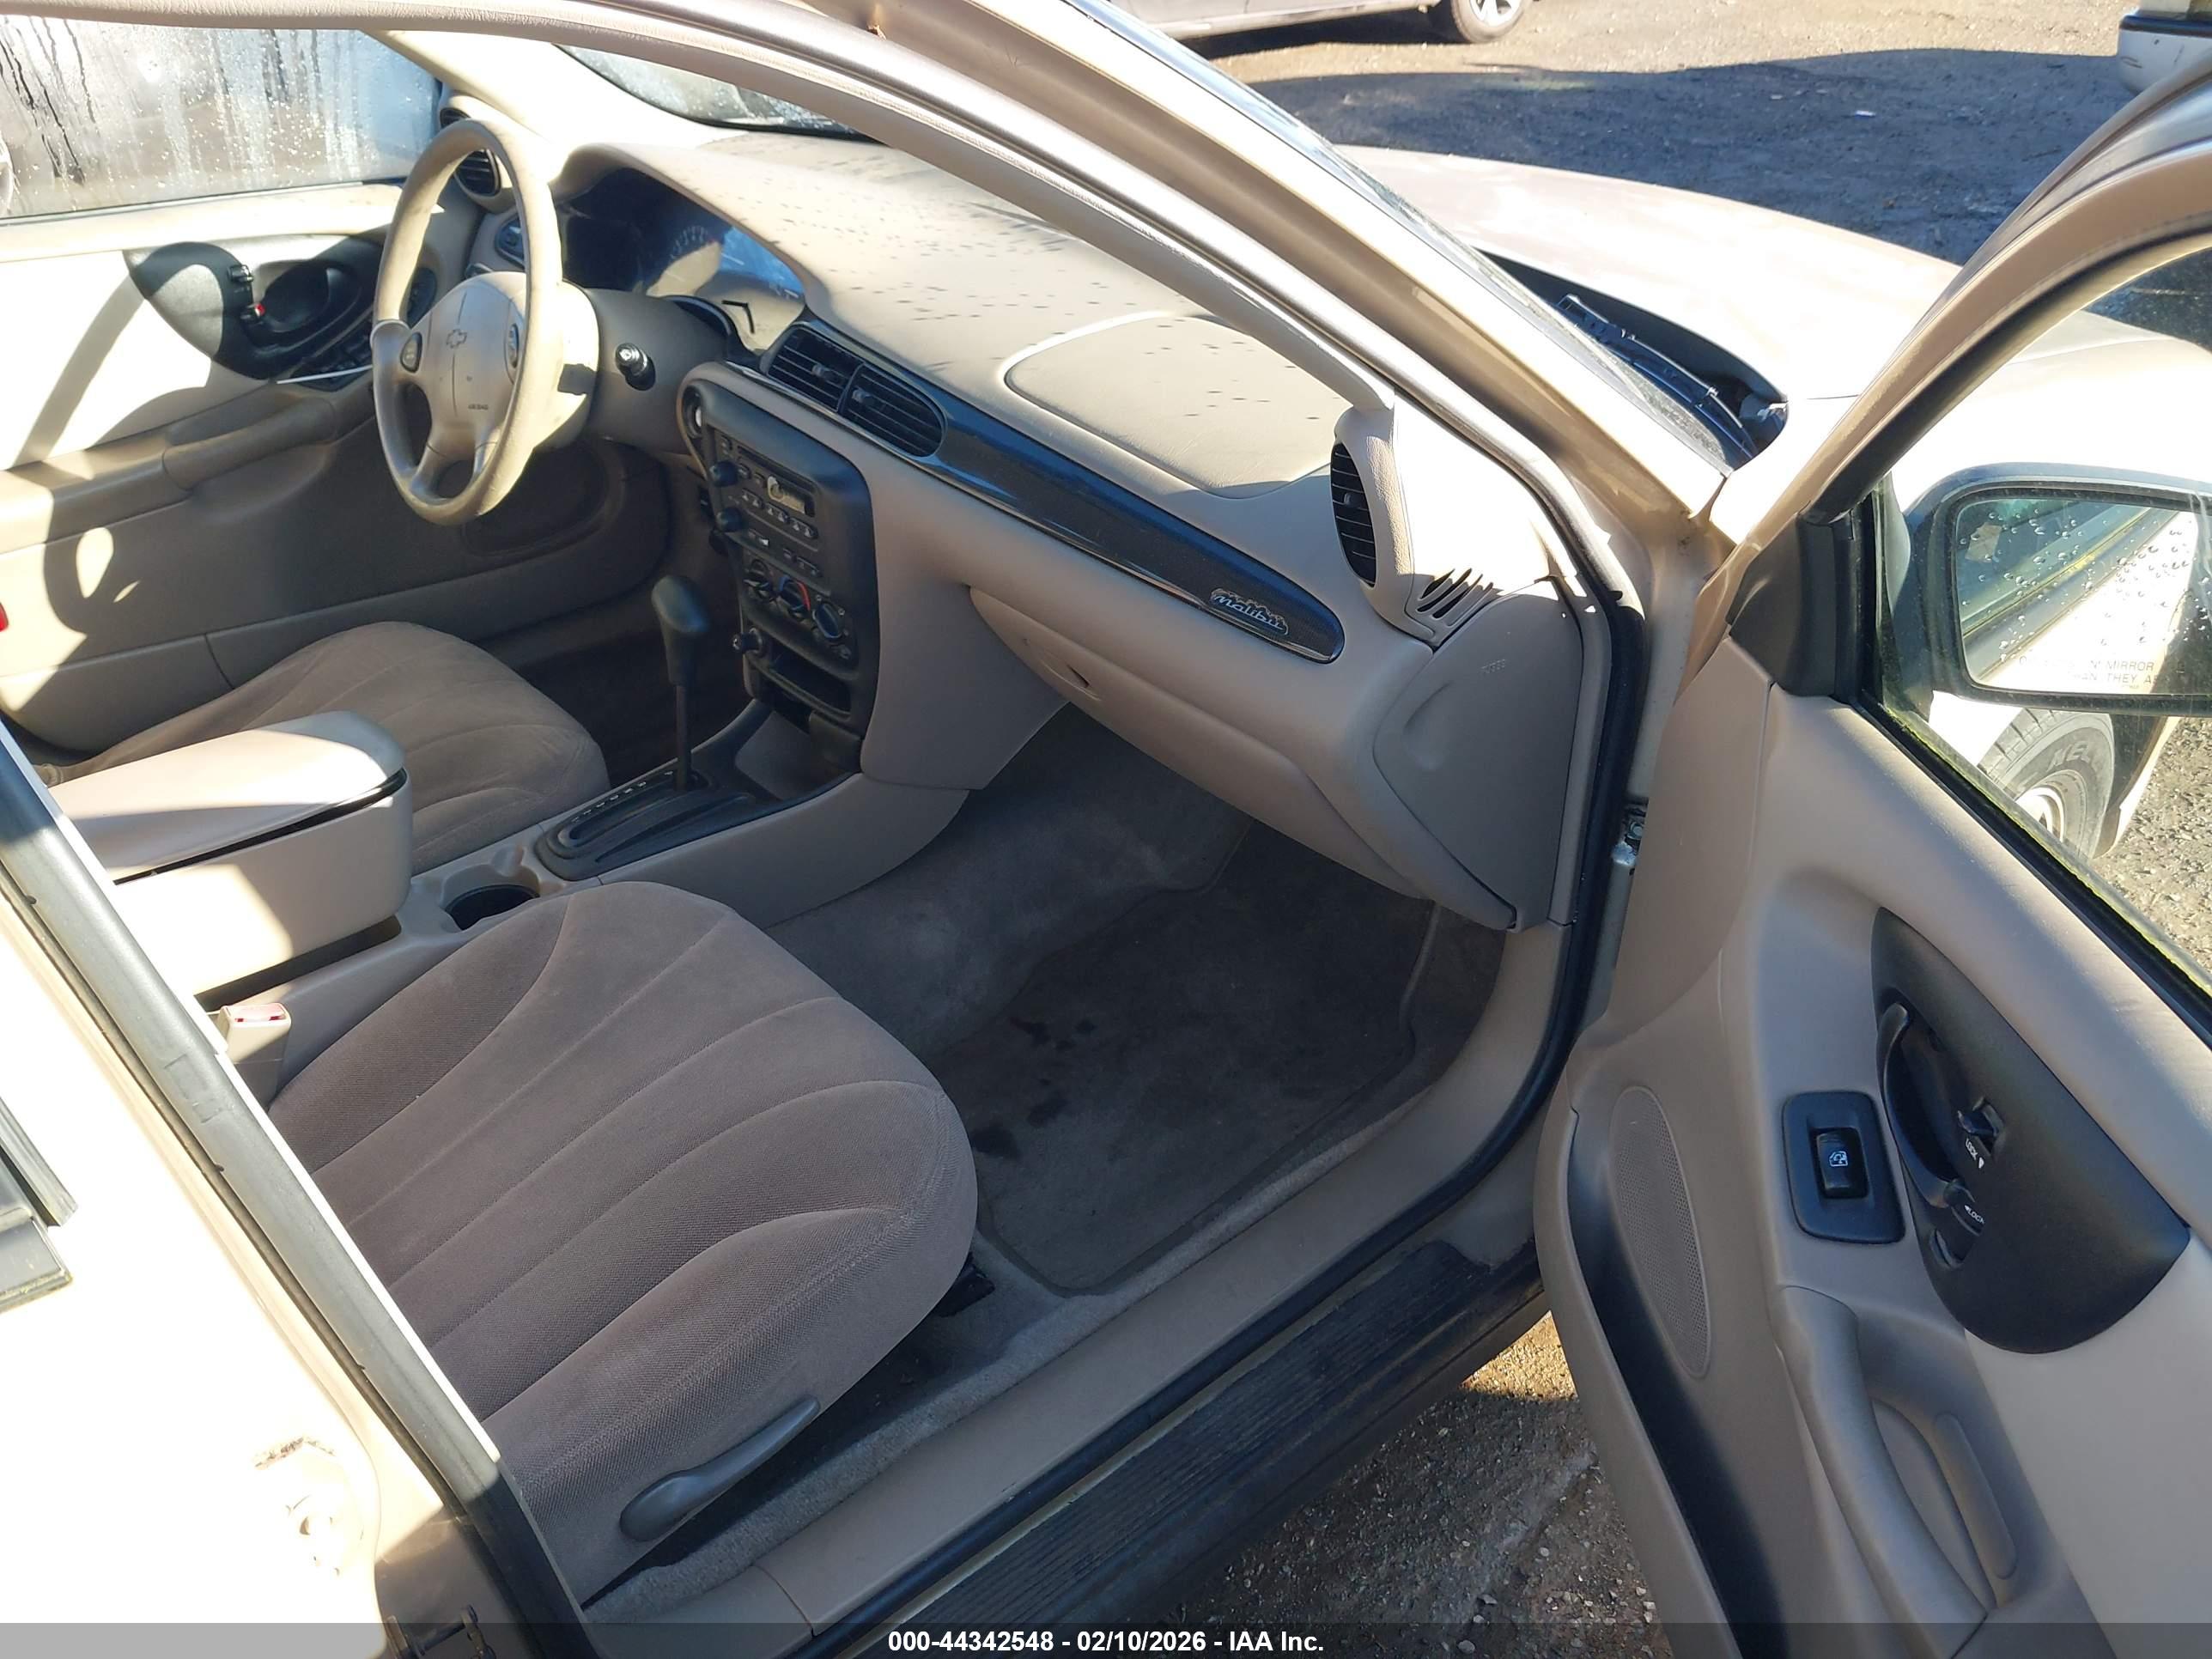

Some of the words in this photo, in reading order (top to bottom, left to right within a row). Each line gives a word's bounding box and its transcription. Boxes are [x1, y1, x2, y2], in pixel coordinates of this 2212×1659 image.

[2106, 659, 2154, 672] MIRROR
[2106, 672, 2138, 684] THEY
[1965, 1138, 1978, 1160] LOCK
